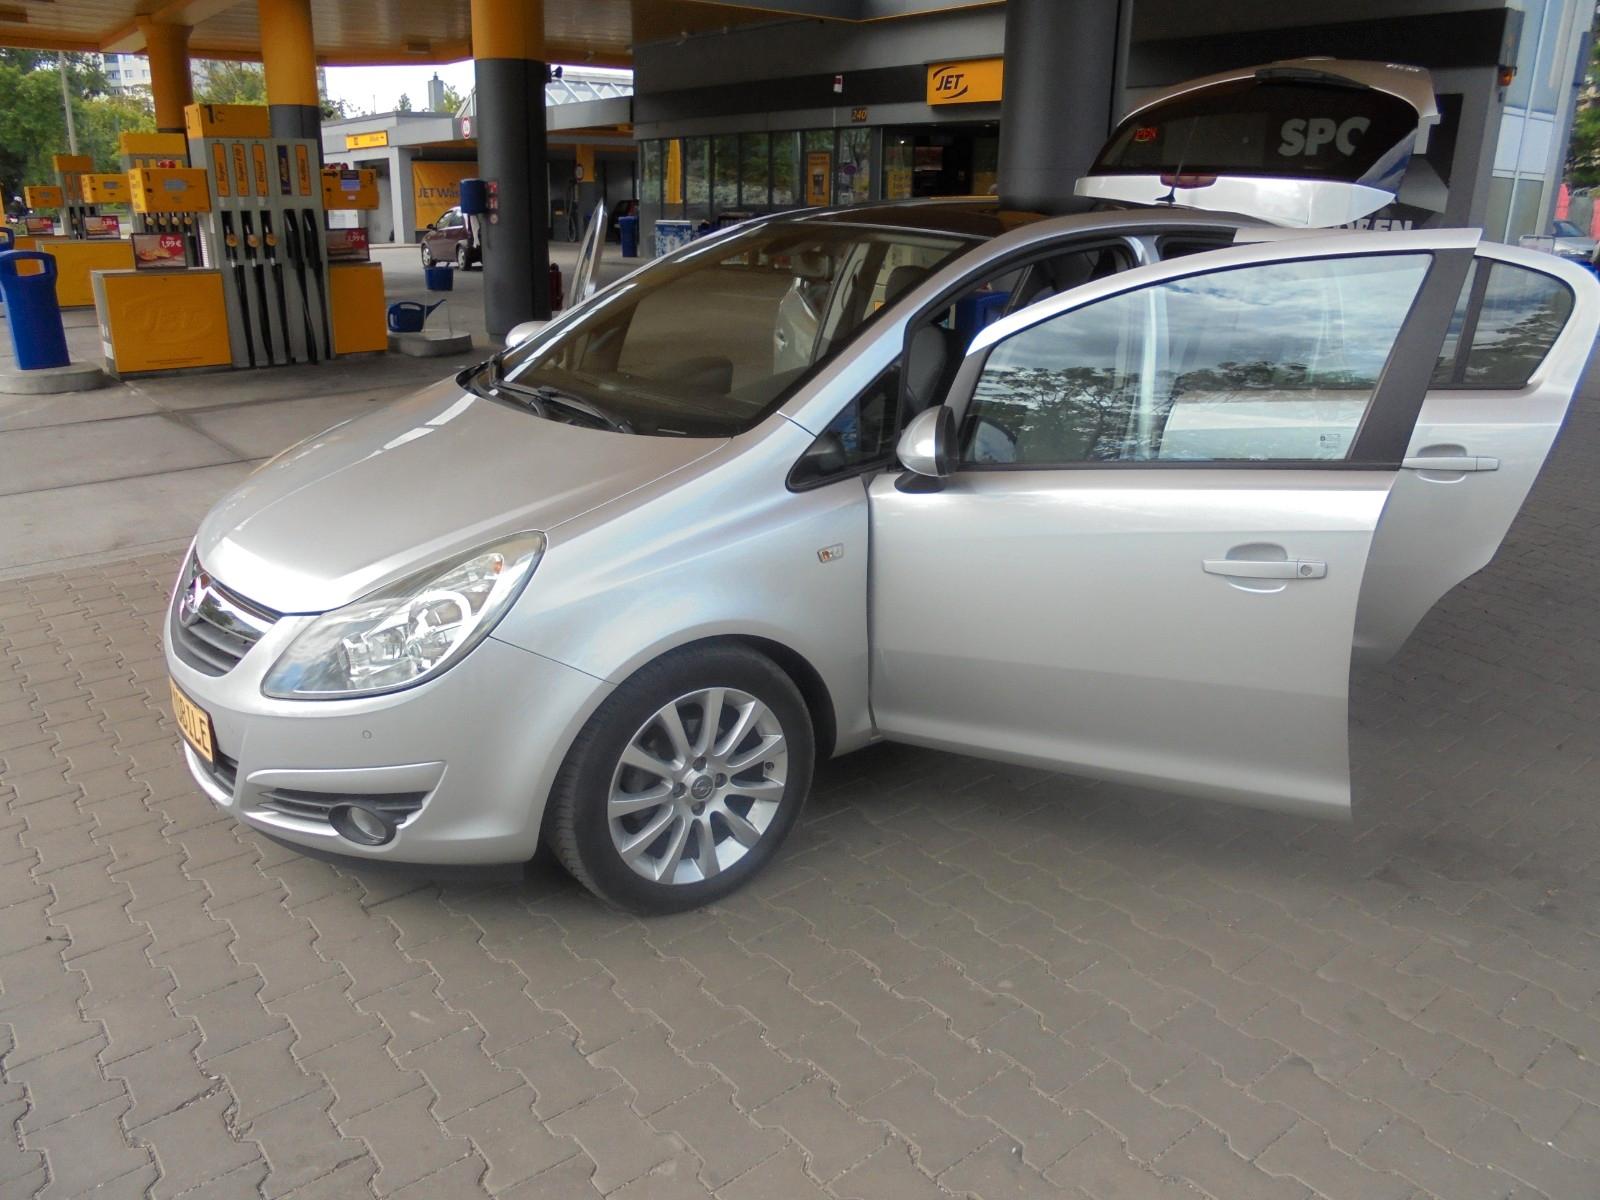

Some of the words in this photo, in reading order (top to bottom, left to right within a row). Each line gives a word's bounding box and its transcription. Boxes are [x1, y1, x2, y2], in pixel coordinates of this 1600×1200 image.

[936, 73, 965, 92] JET
[851, 108, 868, 122] 240
[418, 187, 434, 198] JET
